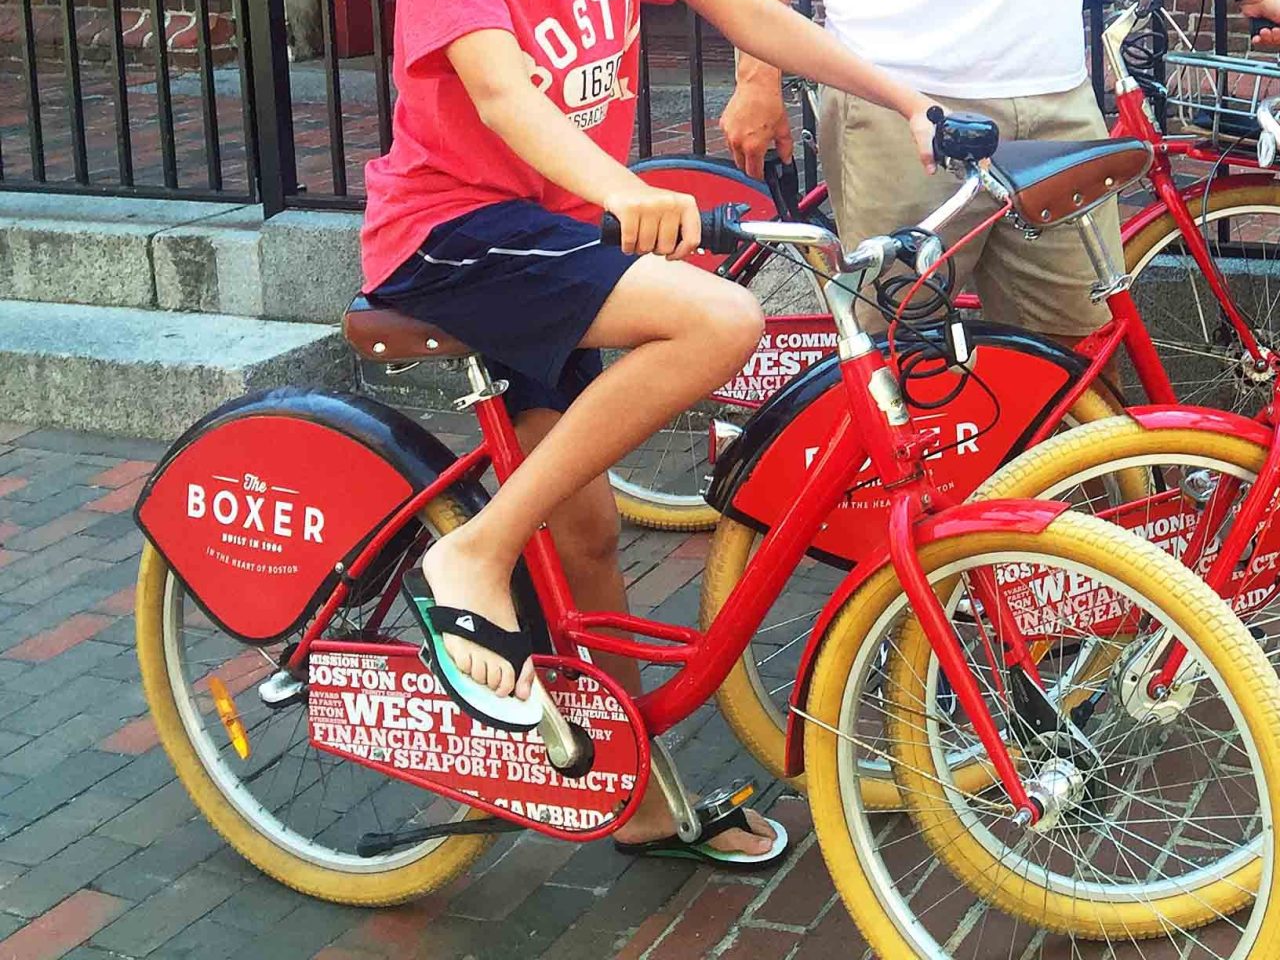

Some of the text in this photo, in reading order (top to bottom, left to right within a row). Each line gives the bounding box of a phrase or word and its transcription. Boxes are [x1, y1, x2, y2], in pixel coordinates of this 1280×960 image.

[776, 332, 841, 349] COMM
[243, 473, 268, 493] The
[187, 483, 326, 544] BOXER
[851, 501, 868, 509] THE
[873, 500, 891, 509] HEA
[222, 533, 247, 546] BUILT
[249, 538, 260, 548] IN
[206, 545, 299, 574] IN THE HEART OF BOSTON
[309, 654, 360, 668] MISSION
[309, 691, 340, 700] ARVARD
[550, 691, 624, 713] VILLAG
[309, 705, 345, 719] HTON
[341, 692, 461, 735] WEST
[313, 722, 442, 752] FINANCIAL
[393, 748, 501, 779] SEAPORT
